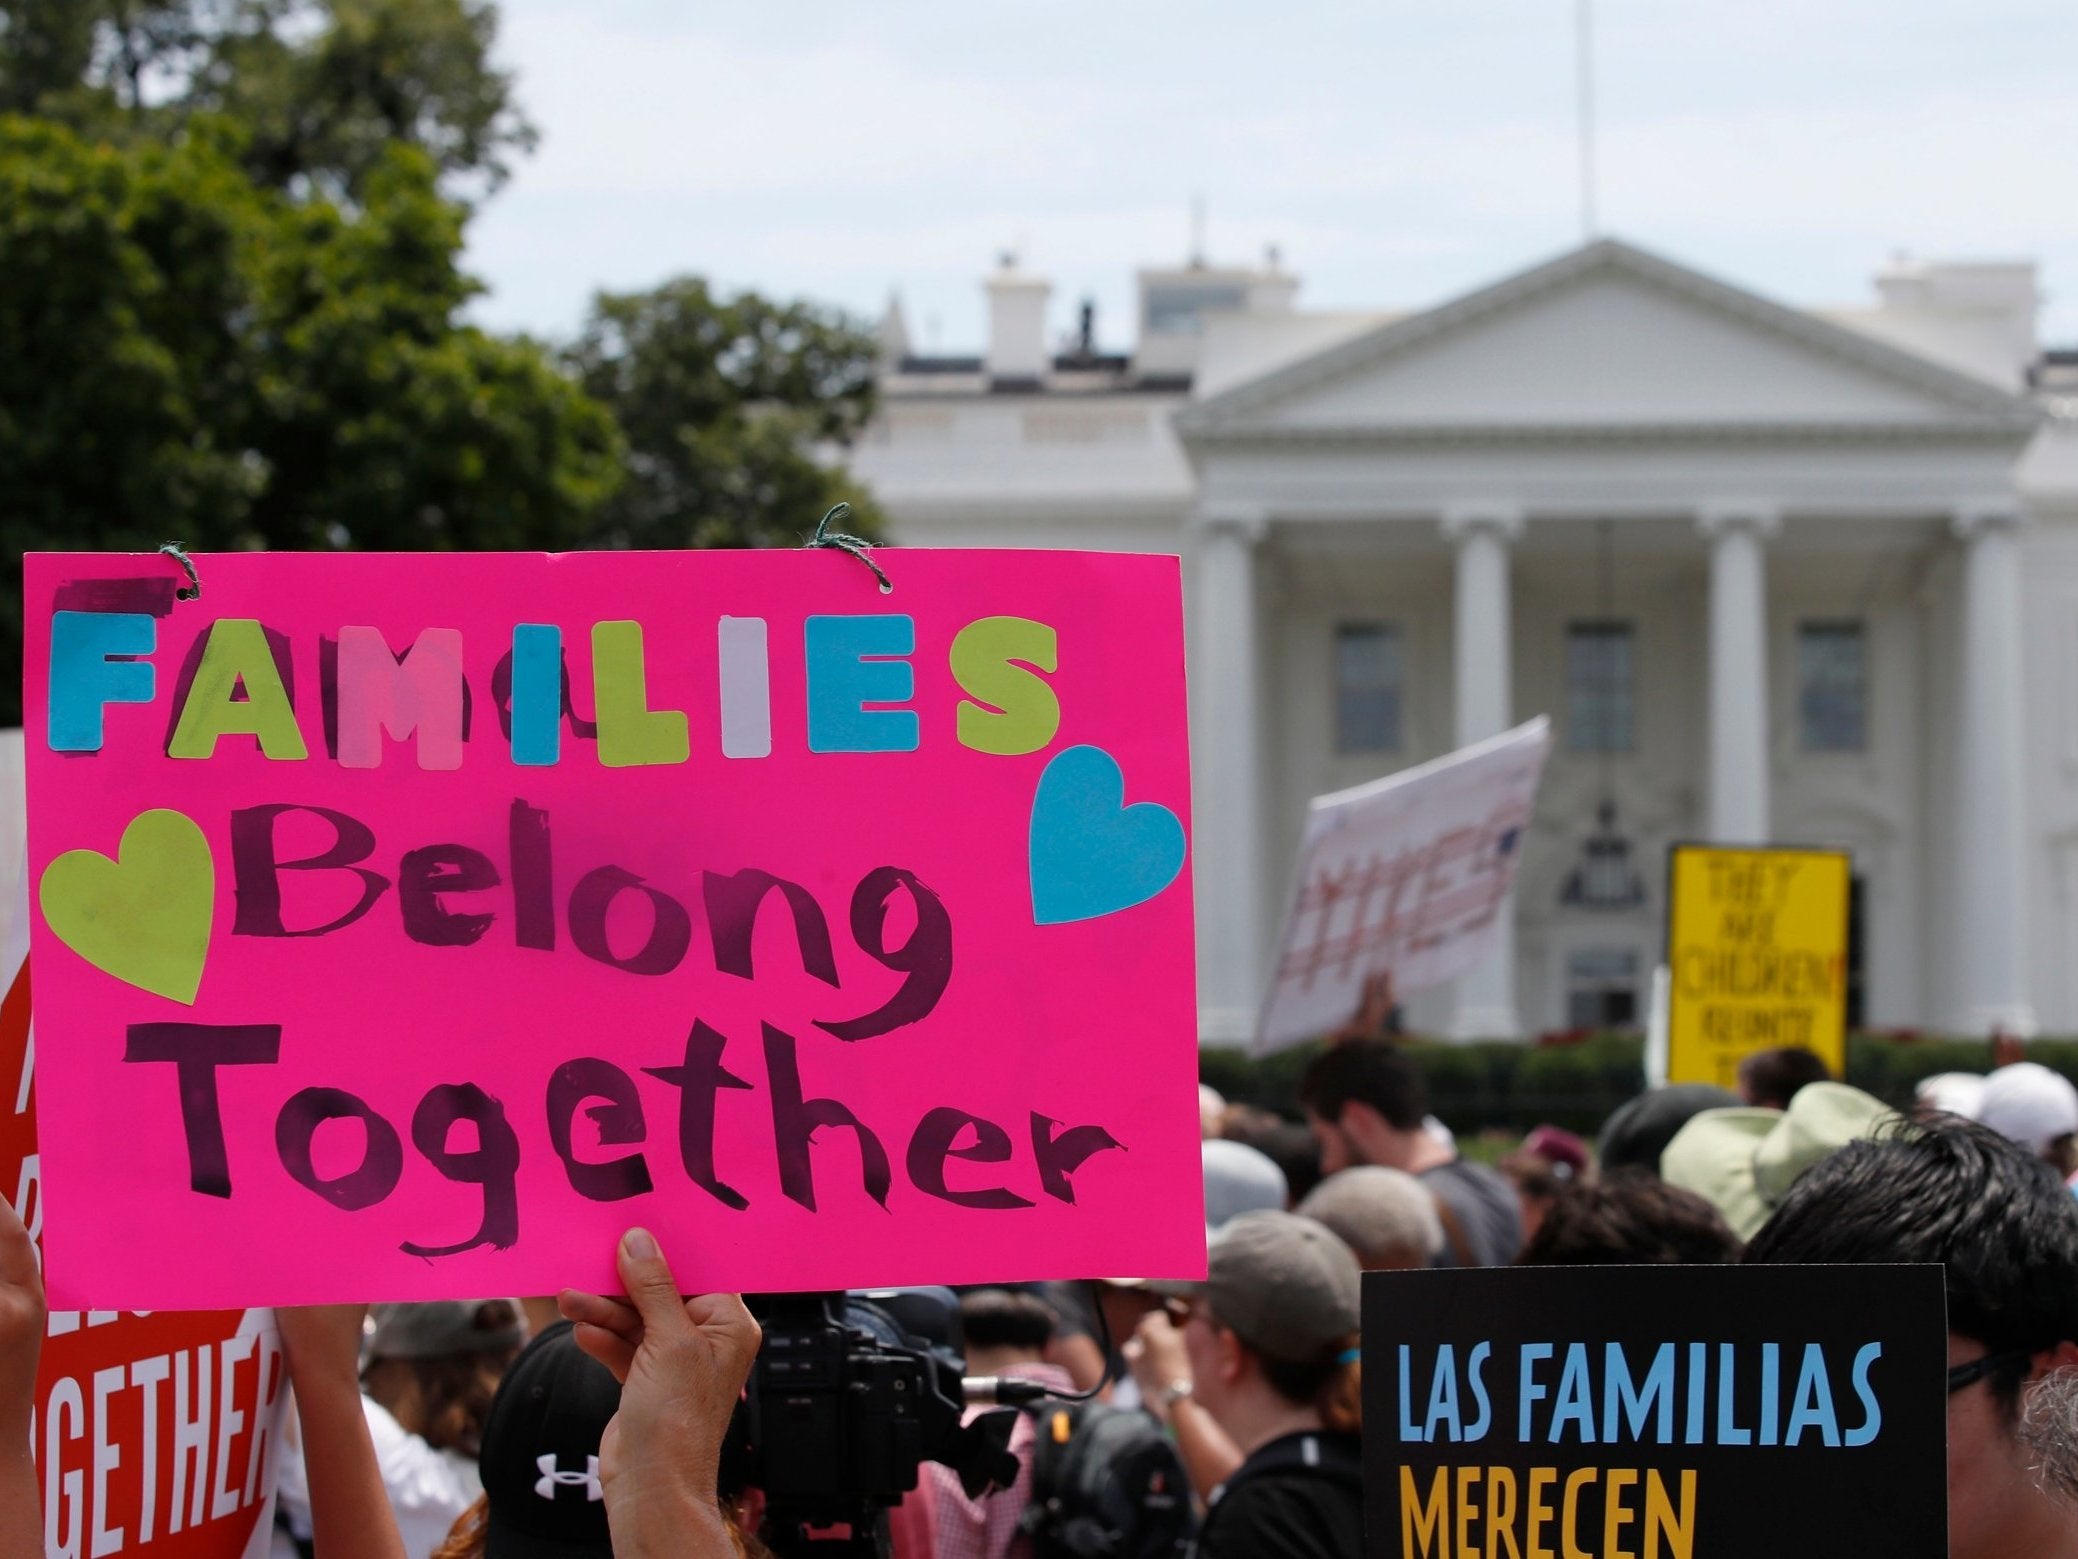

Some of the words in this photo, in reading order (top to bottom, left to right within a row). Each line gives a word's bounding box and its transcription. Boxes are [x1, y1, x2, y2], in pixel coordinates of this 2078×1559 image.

[48, 611, 1060, 771] FAMILIES
[231, 798, 953, 1042] Belong
[122, 1017, 1129, 1266] Together
[30, 1334, 280, 1559] GETHER
[1399, 1341, 1491, 1443] LAS
[1518, 1341, 1882, 1447] FAMILIAS
[1400, 1465, 1697, 1559] MERECEN
